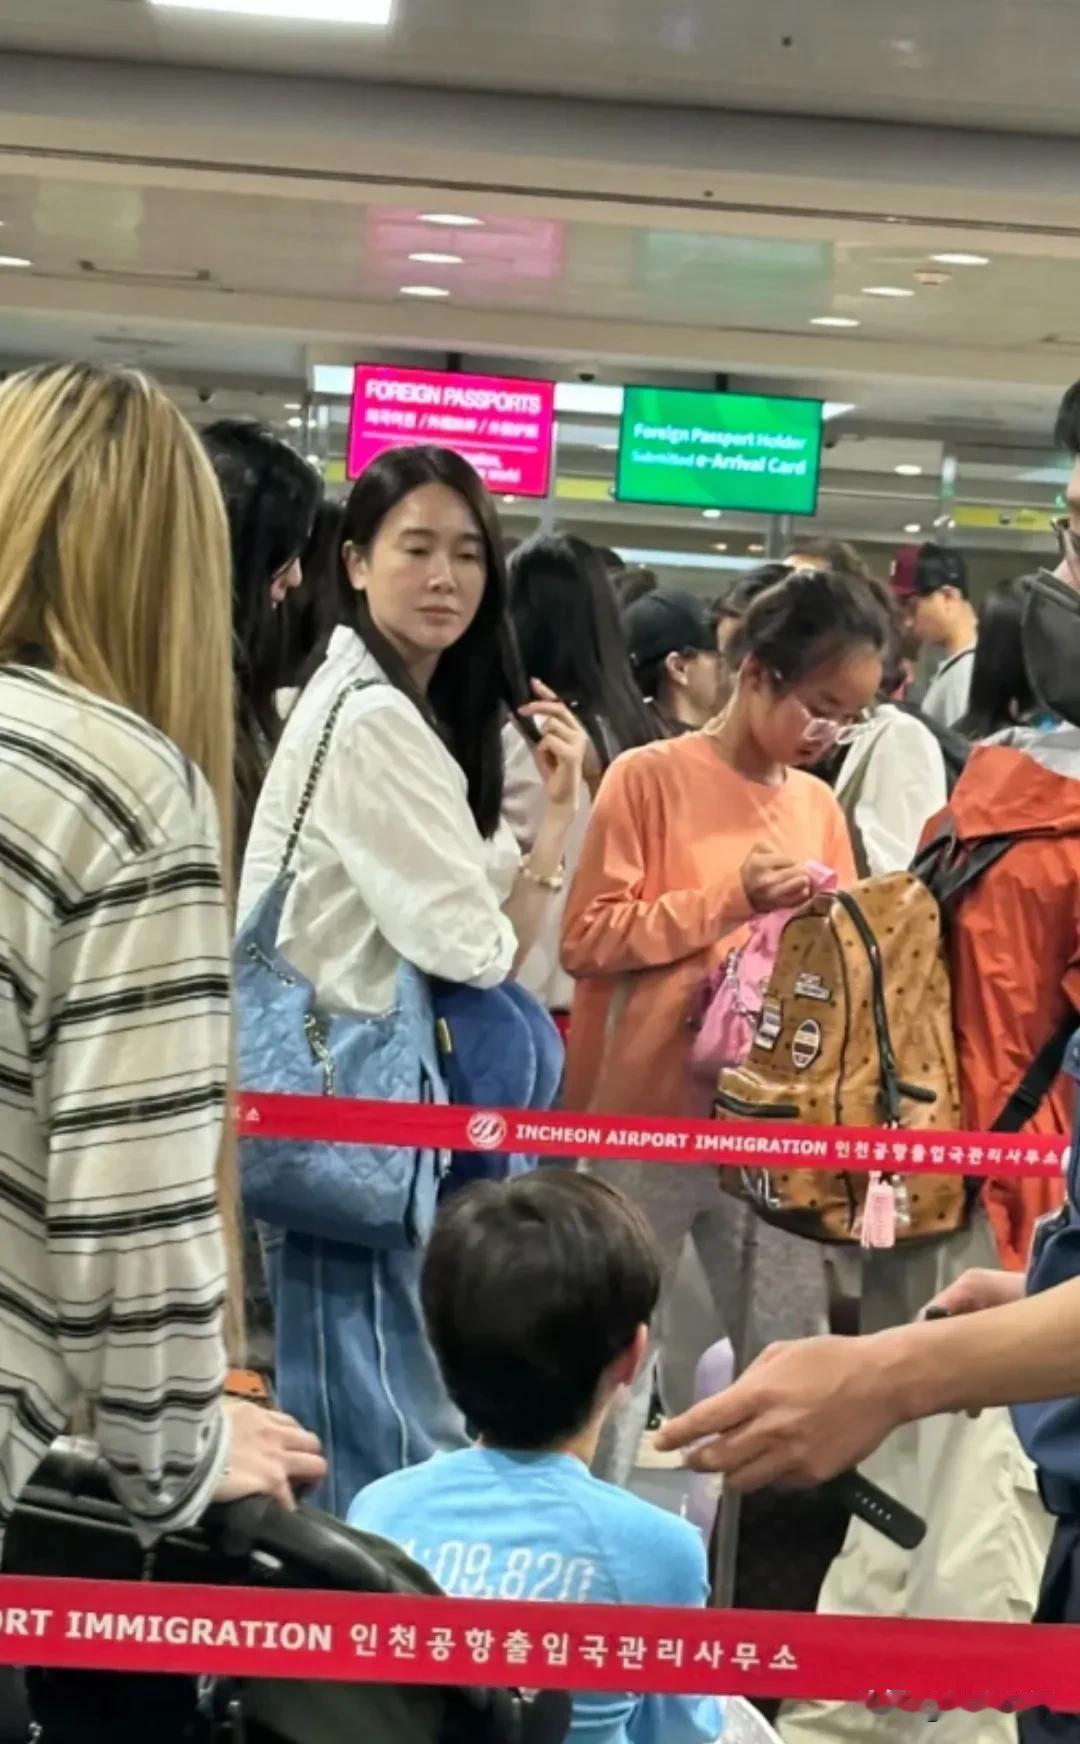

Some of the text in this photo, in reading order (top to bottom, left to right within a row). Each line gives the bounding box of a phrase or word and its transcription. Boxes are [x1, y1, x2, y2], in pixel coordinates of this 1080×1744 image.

[365, 379, 542, 415] FOREIGN PASSPORTS
[633, 422, 807, 450] Foreign Passport Holder
[695, 453, 765, 472] e-Arrival
[767, 458, 807, 475] Card
[515, 1123, 600, 1145] INCHEON
[606, 1129, 688, 1149] AIRPORT
[695, 1134, 828, 1156] IMMIGRATION
[0, 1607, 54, 1638] RT
[65, 1609, 333, 1653] IMMIGRATION
